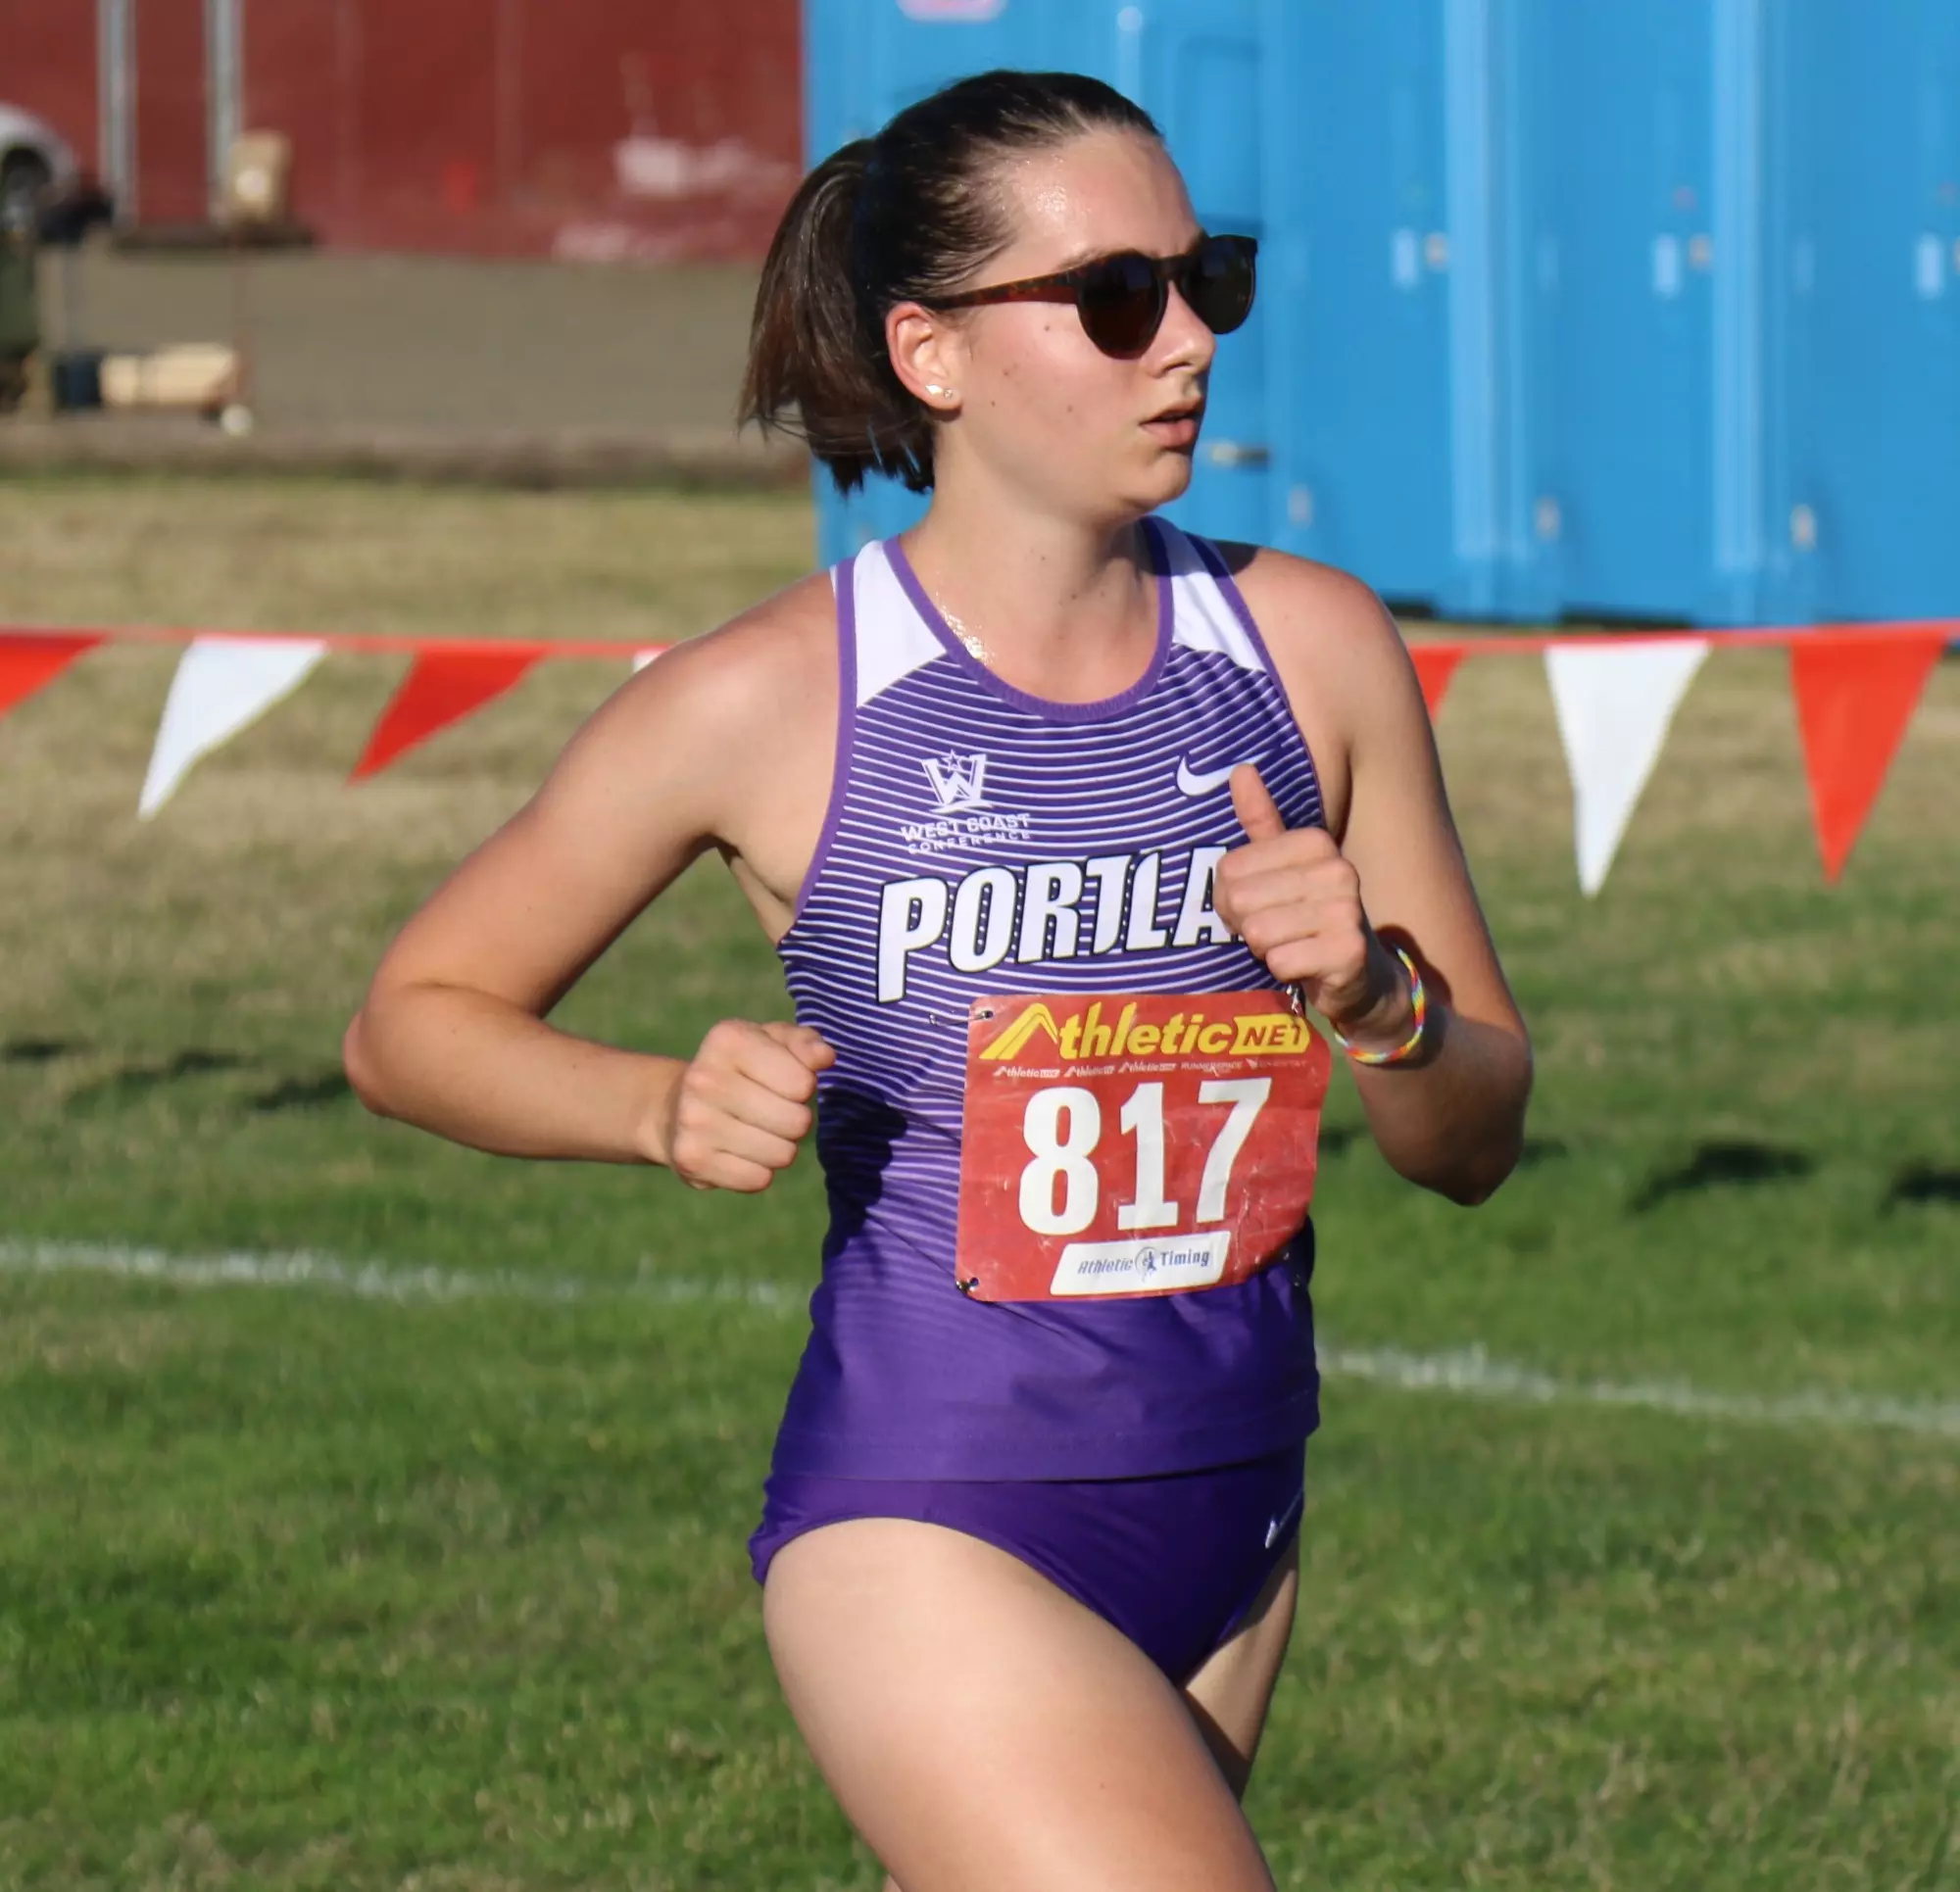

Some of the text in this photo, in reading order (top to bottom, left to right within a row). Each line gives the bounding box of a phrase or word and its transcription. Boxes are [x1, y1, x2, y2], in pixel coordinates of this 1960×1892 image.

[901, 812, 1031, 842] WEST COAST
[906, 831, 1031, 854] CONFERENCE
[877, 845, 1246, 1003] PORTLA
[1018, 1078, 1272, 1236] 817
[1078, 1248, 1210, 1275] Athletic Timing
